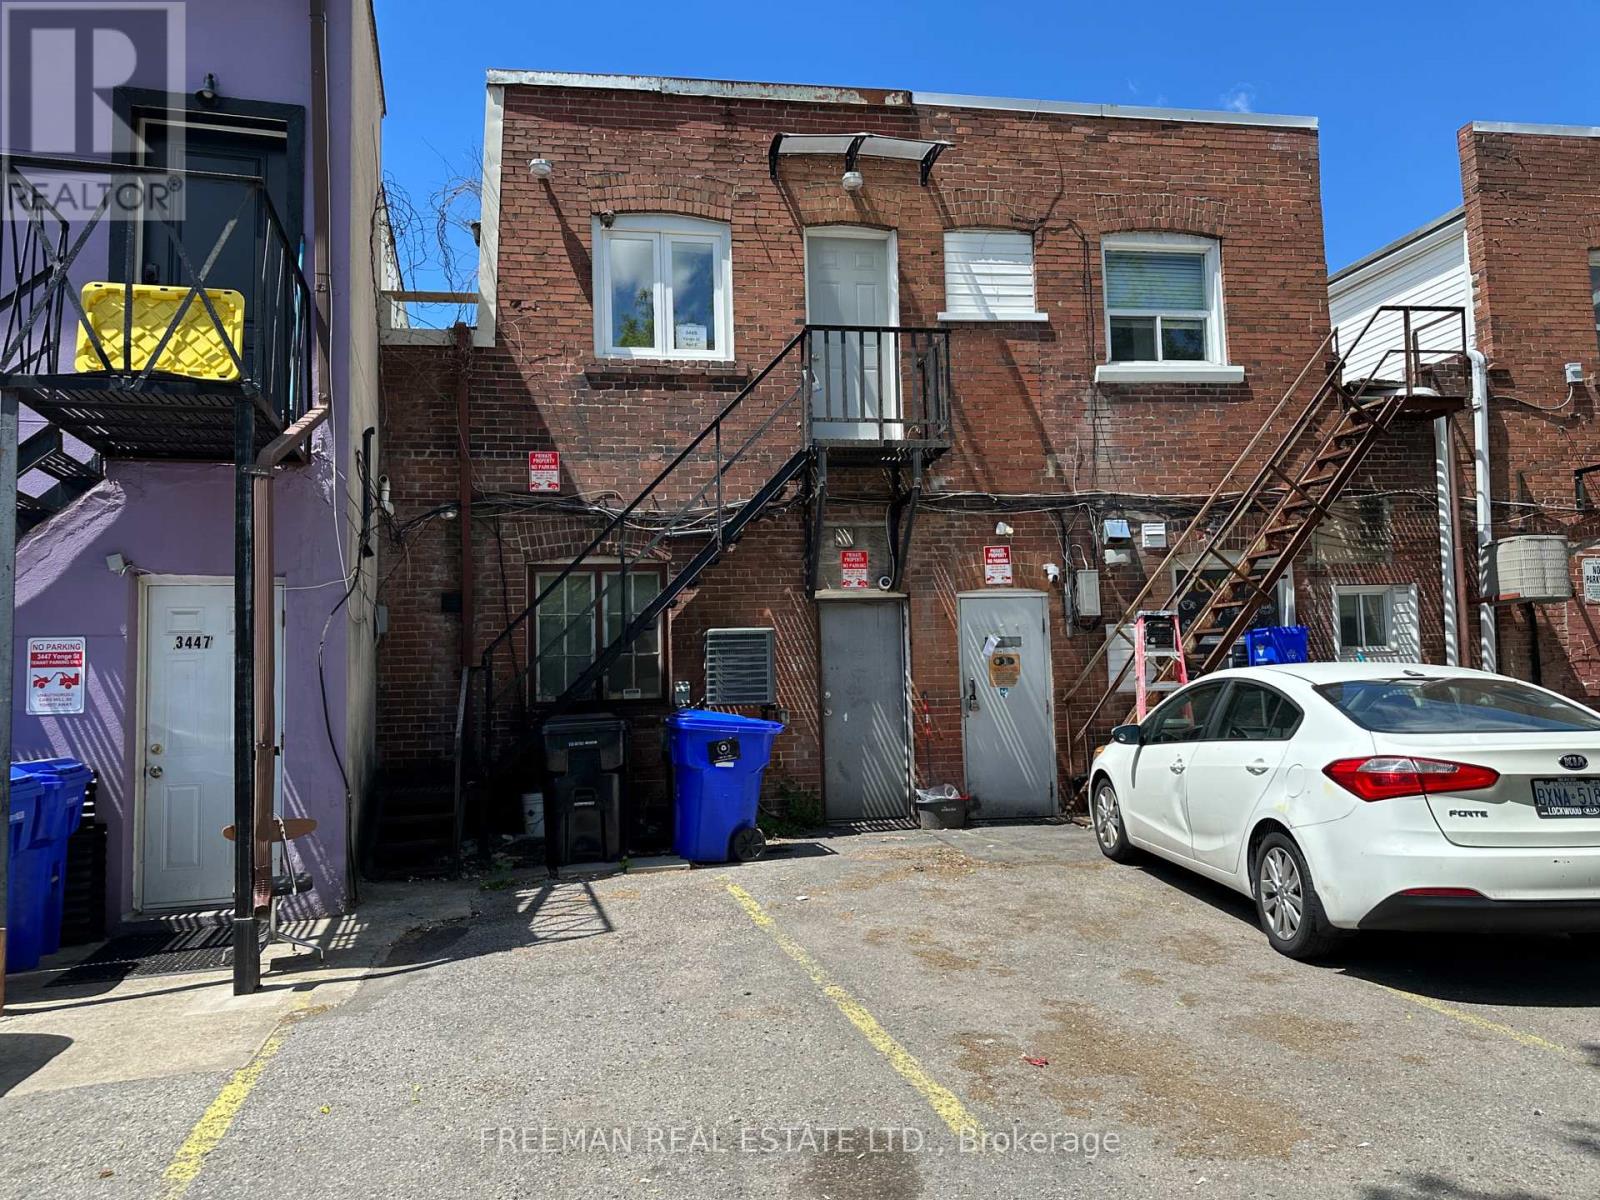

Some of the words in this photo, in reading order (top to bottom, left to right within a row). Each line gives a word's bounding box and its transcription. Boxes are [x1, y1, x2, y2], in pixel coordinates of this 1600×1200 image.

[32, 643, 45, 651] NO
[46, 643, 81, 651] PARKING
[1564, 756, 1585, 767] KIA
[1449, 809, 1488, 818] FORTE
[1547, 806, 1582, 815] LOCKWOOD
